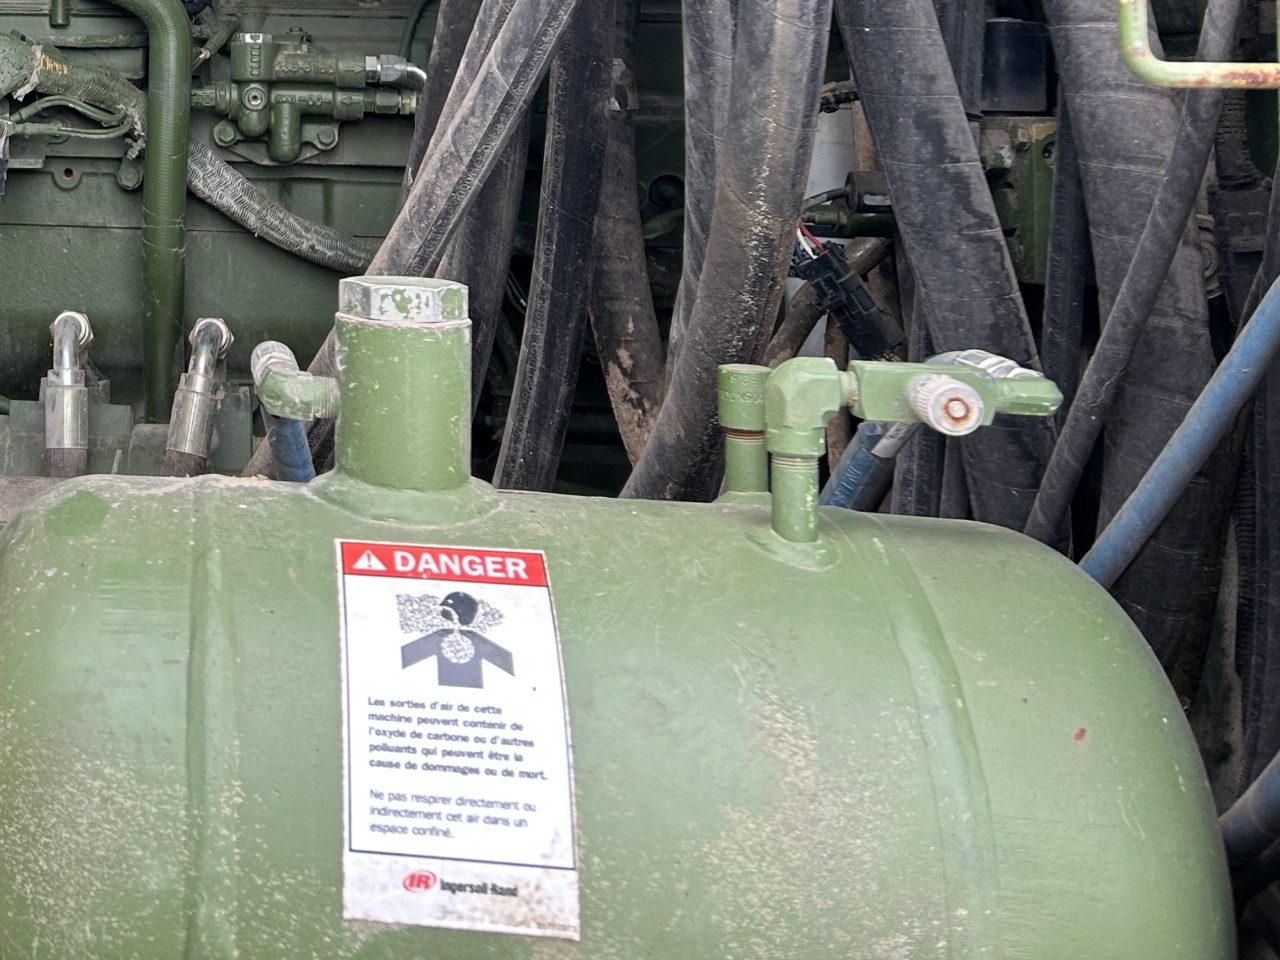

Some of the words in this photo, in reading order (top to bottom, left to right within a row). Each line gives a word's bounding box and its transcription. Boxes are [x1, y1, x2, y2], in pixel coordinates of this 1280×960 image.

[392, 550, 529, 580] DANGER
[368, 696, 385, 707] Les
[390, 699, 426, 710] sorties
[430, 701, 454, 711] d'air
[457, 703, 470, 713] de
[473, 704, 502, 715] cette
[368, 712, 413, 724] machine
[417, 716, 459, 727] peuvent
[463, 719, 507, 730] contenir
[510, 722, 524, 732] de
[368, 725, 406, 740] l'oxyde
[410, 729, 423, 739] de
[427, 732, 470, 743] carbone
[473, 735, 487, 744] ou
[490, 735, 535, 748] d'autres
[369, 742, 417, 755] polluants
[421, 745, 438, 758] qui
[441, 748, 485, 760] peuvent
[369, 759, 401, 769] cause
[404, 760, 418, 770] de
[422, 762, 480, 776] dommages
[484, 767, 497, 776] ou
[501, 768, 514, 778] de
[369, 788, 384, 801] Ne
[388, 791, 408, 803] pas
[411, 793, 452, 807] respirer
[455, 795, 520, 812] directement
[523, 802, 537, 813] ou
[369, 805, 443, 821] indirectement
[446, 812, 463, 823] cet
[466, 813, 480, 824] air
[483, 815, 511, 828] dans
[514, 818, 528, 828] un
[369, 823, 408, 835] espace
